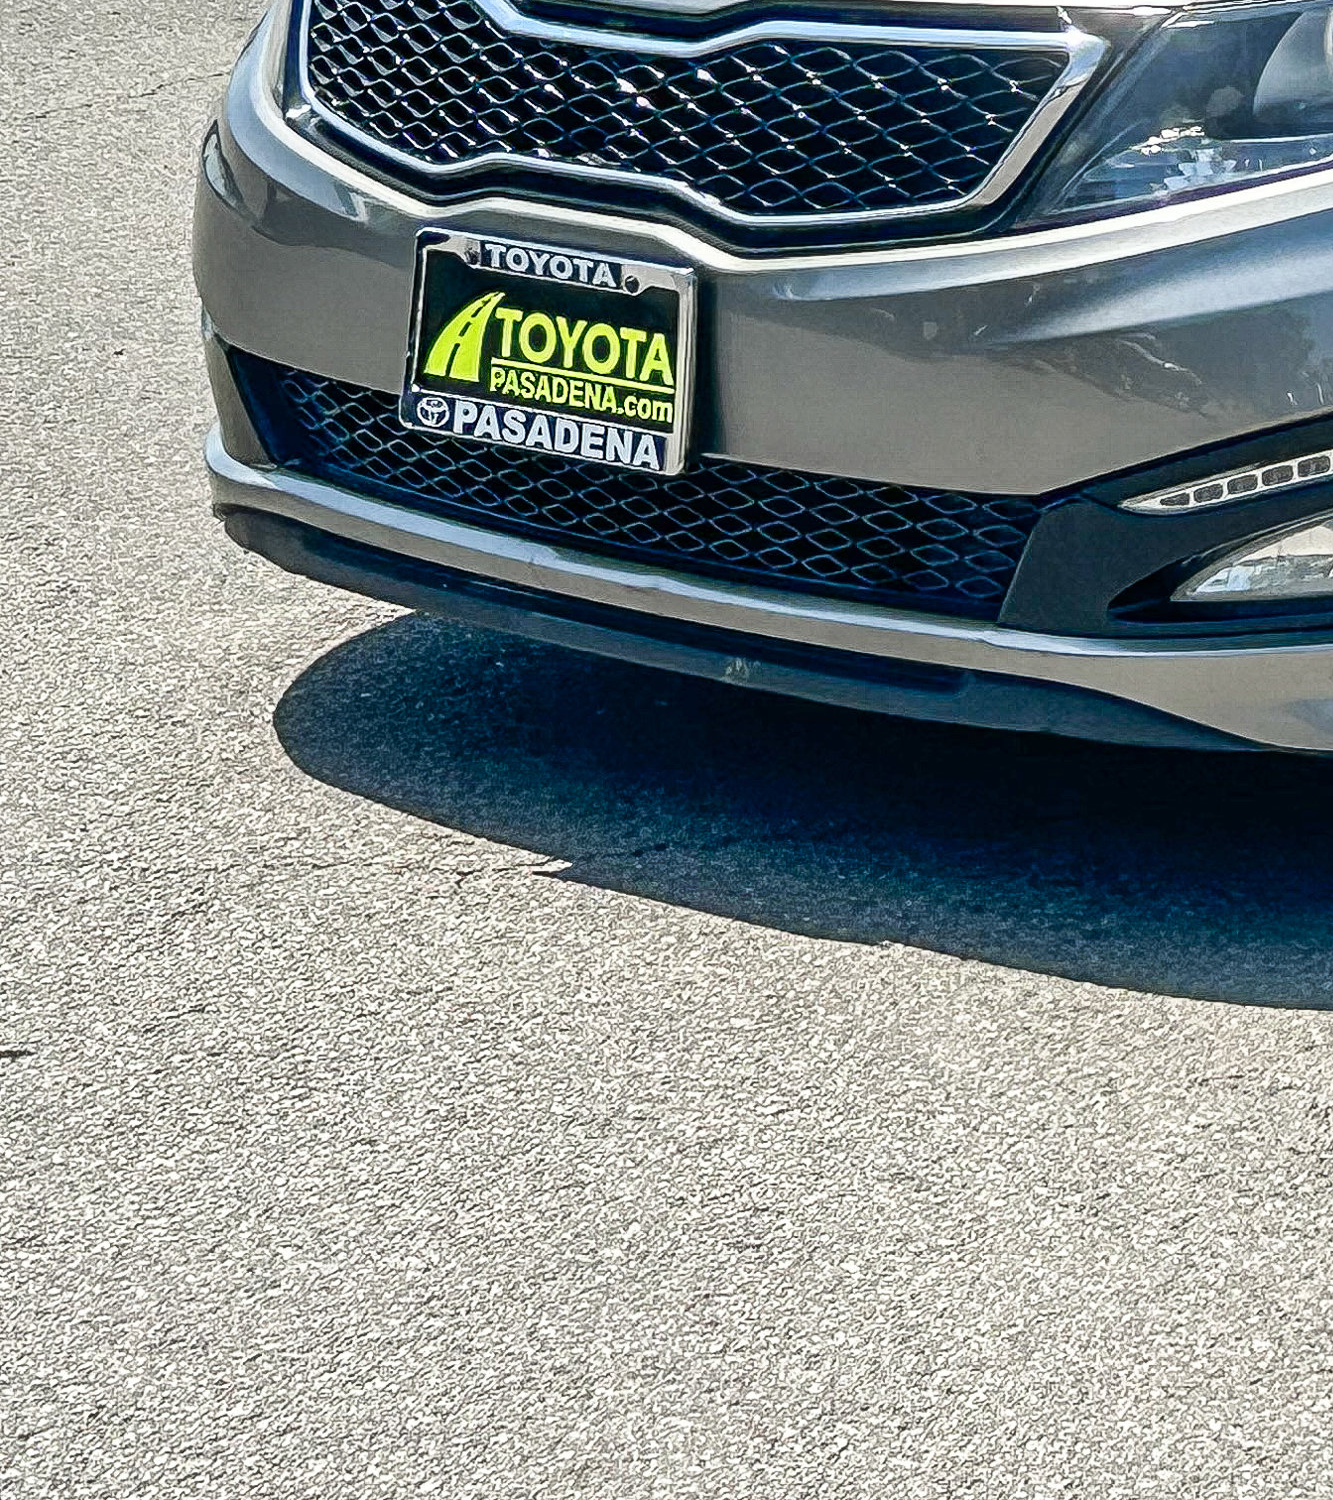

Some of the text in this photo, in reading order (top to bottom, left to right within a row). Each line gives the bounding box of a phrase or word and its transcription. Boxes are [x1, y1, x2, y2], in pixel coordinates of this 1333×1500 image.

[484, 242, 616, 288] TOYOTA
[496, 306, 675, 385] TOYOTA
[490, 366, 673, 424] PASADENA.com
[452, 400, 661, 471] PASADENA
